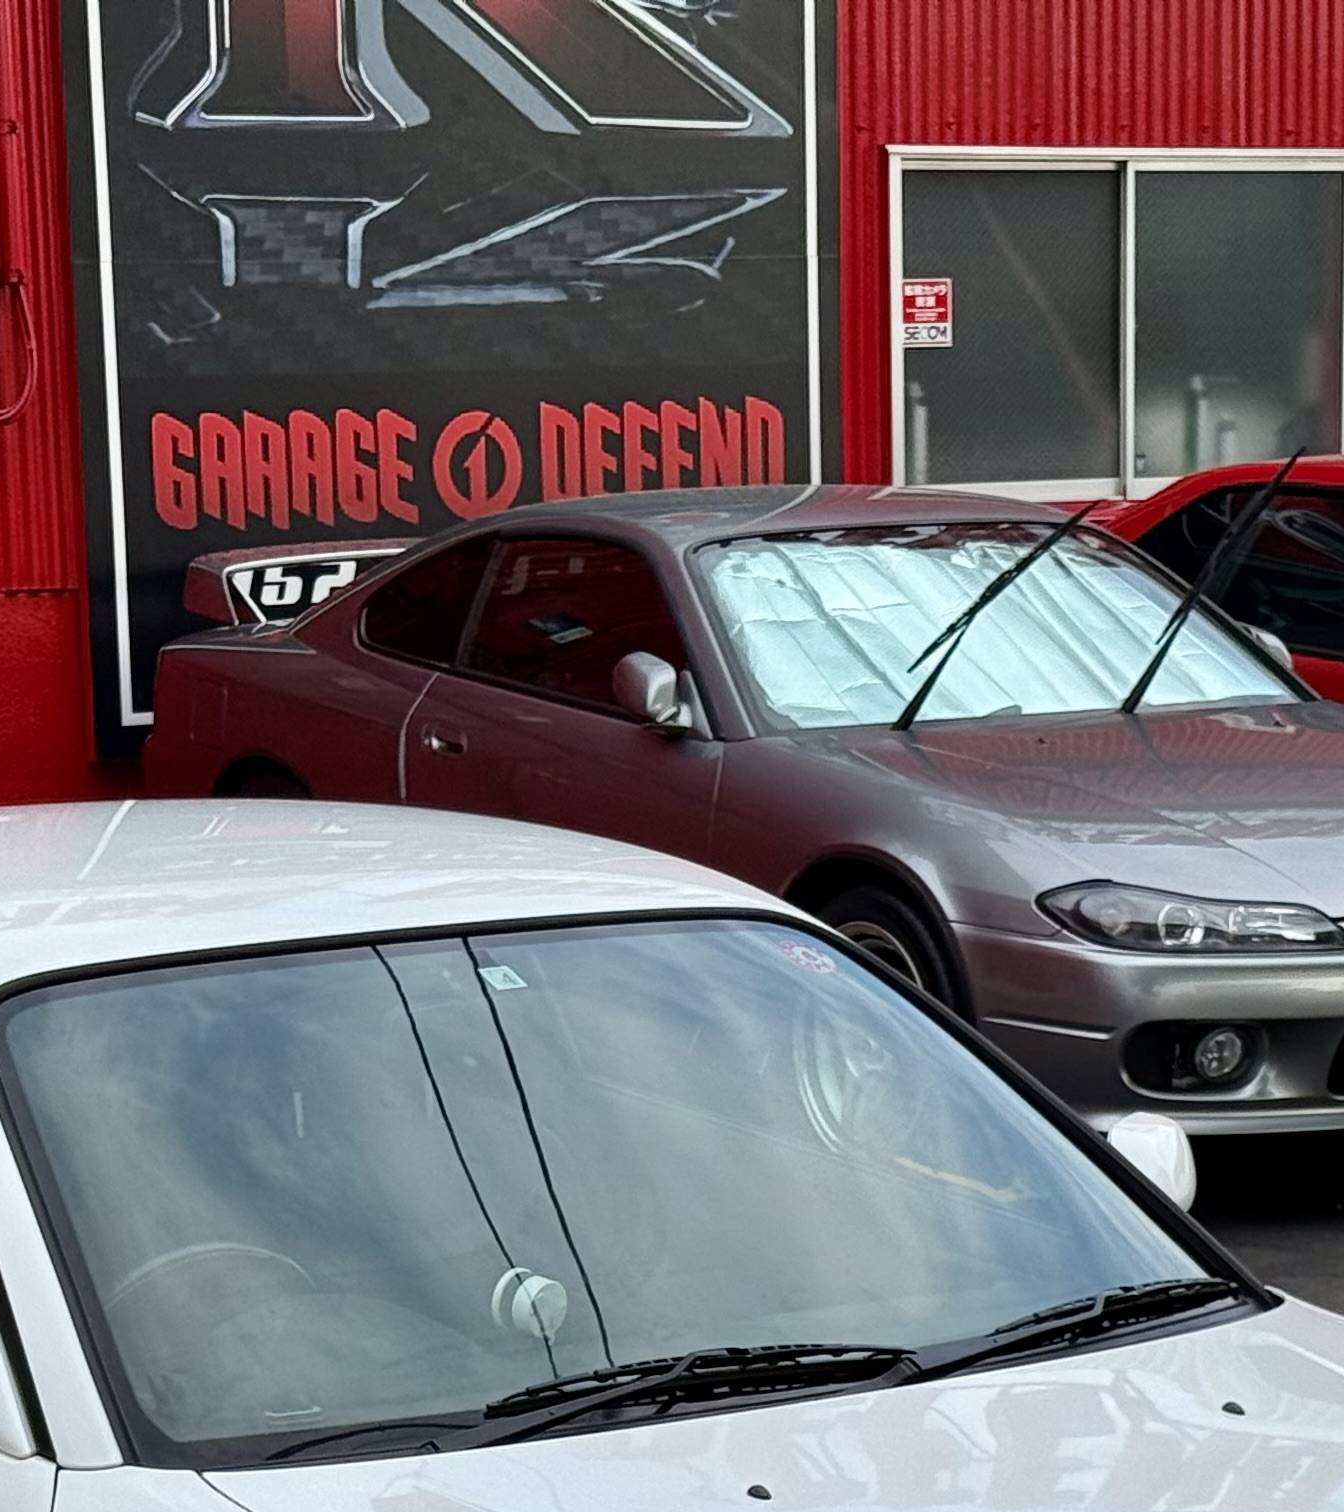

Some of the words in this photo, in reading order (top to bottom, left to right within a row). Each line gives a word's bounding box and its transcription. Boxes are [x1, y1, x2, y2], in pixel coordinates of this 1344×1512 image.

[904, 325, 947, 341] SECOM
[151, 408, 420, 532] GARAGE
[539, 395, 785, 504] DEFEND
